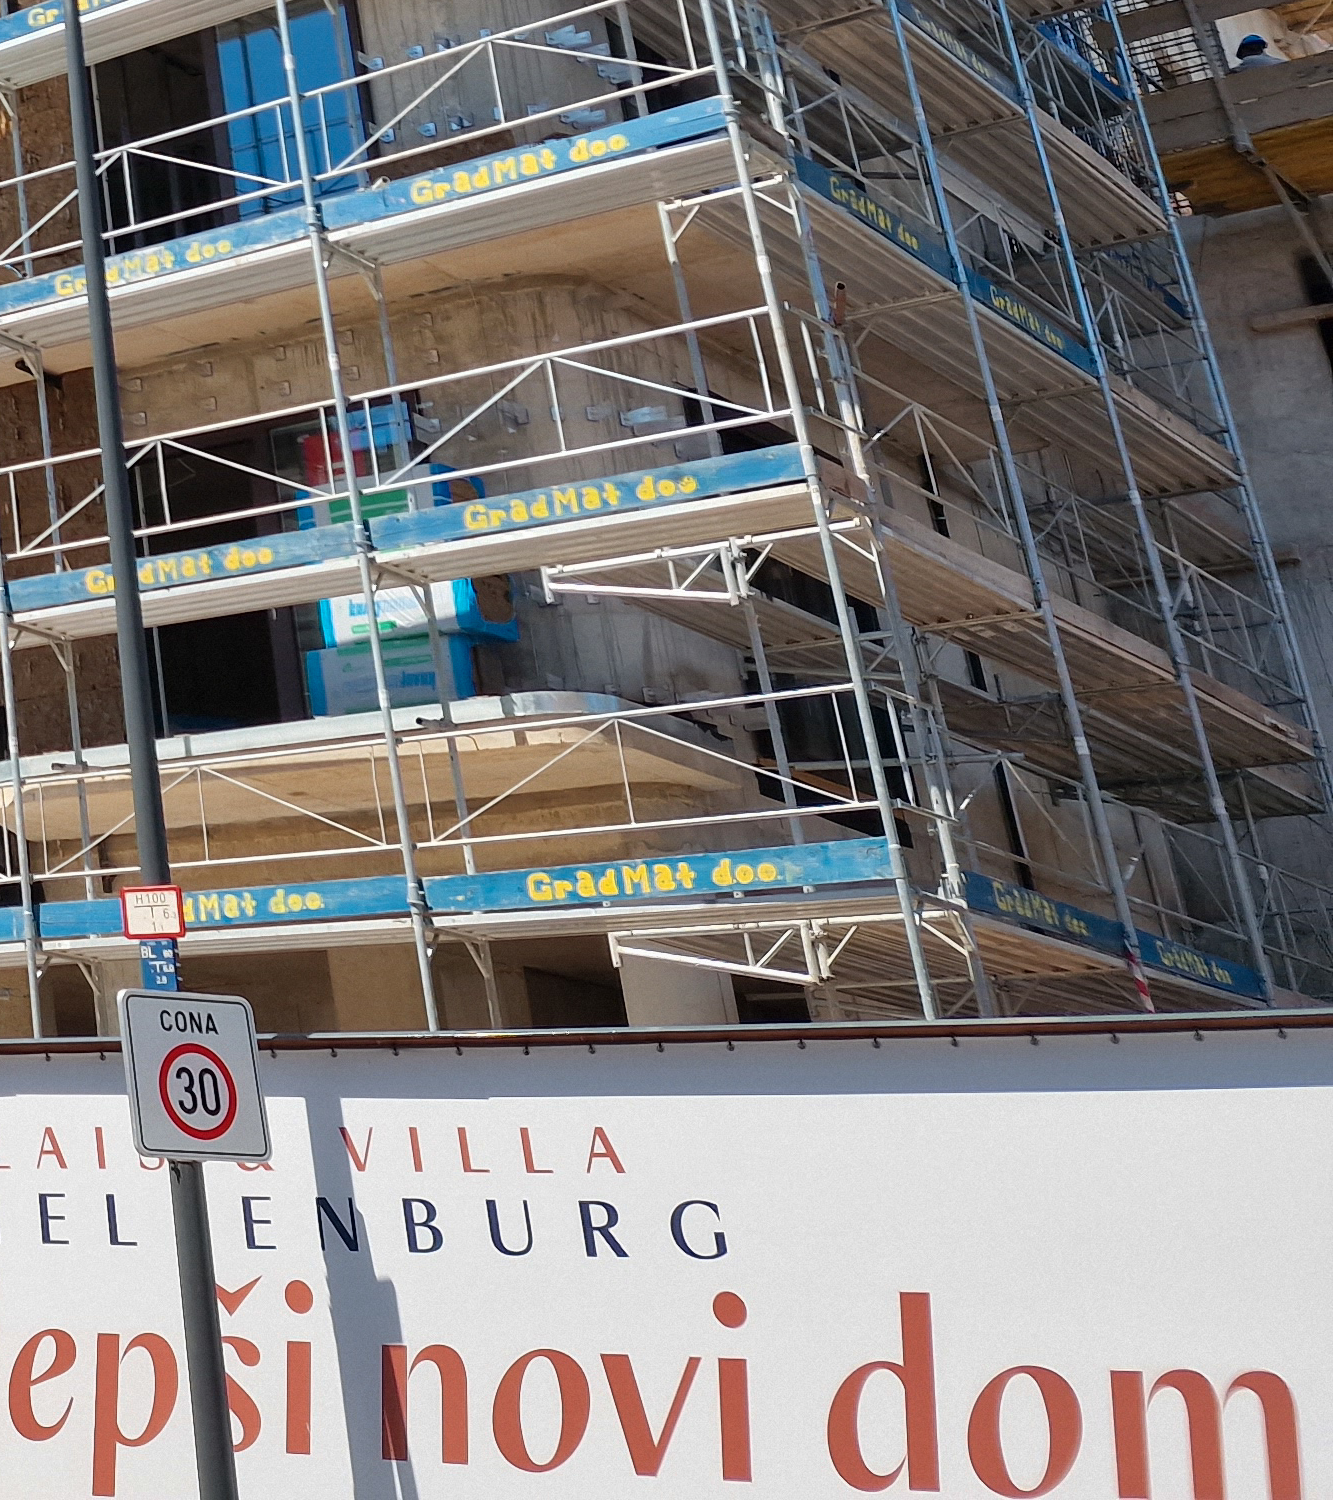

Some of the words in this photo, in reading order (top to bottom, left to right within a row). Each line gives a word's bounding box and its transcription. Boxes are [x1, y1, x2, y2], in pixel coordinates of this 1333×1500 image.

[410, 148, 557, 203] GradMat
[463, 483, 622, 531] GradMat
[135, 892, 166, 905] H100
[527, 862, 697, 902] GradMat
[159, 1009, 219, 1035] CONA
[175, 1066, 222, 1117] 30
[338, 1126, 626, 1174] VILLA
[381, 1290, 753, 1483] novi
[826, 1290, 1303, 1500] dom
